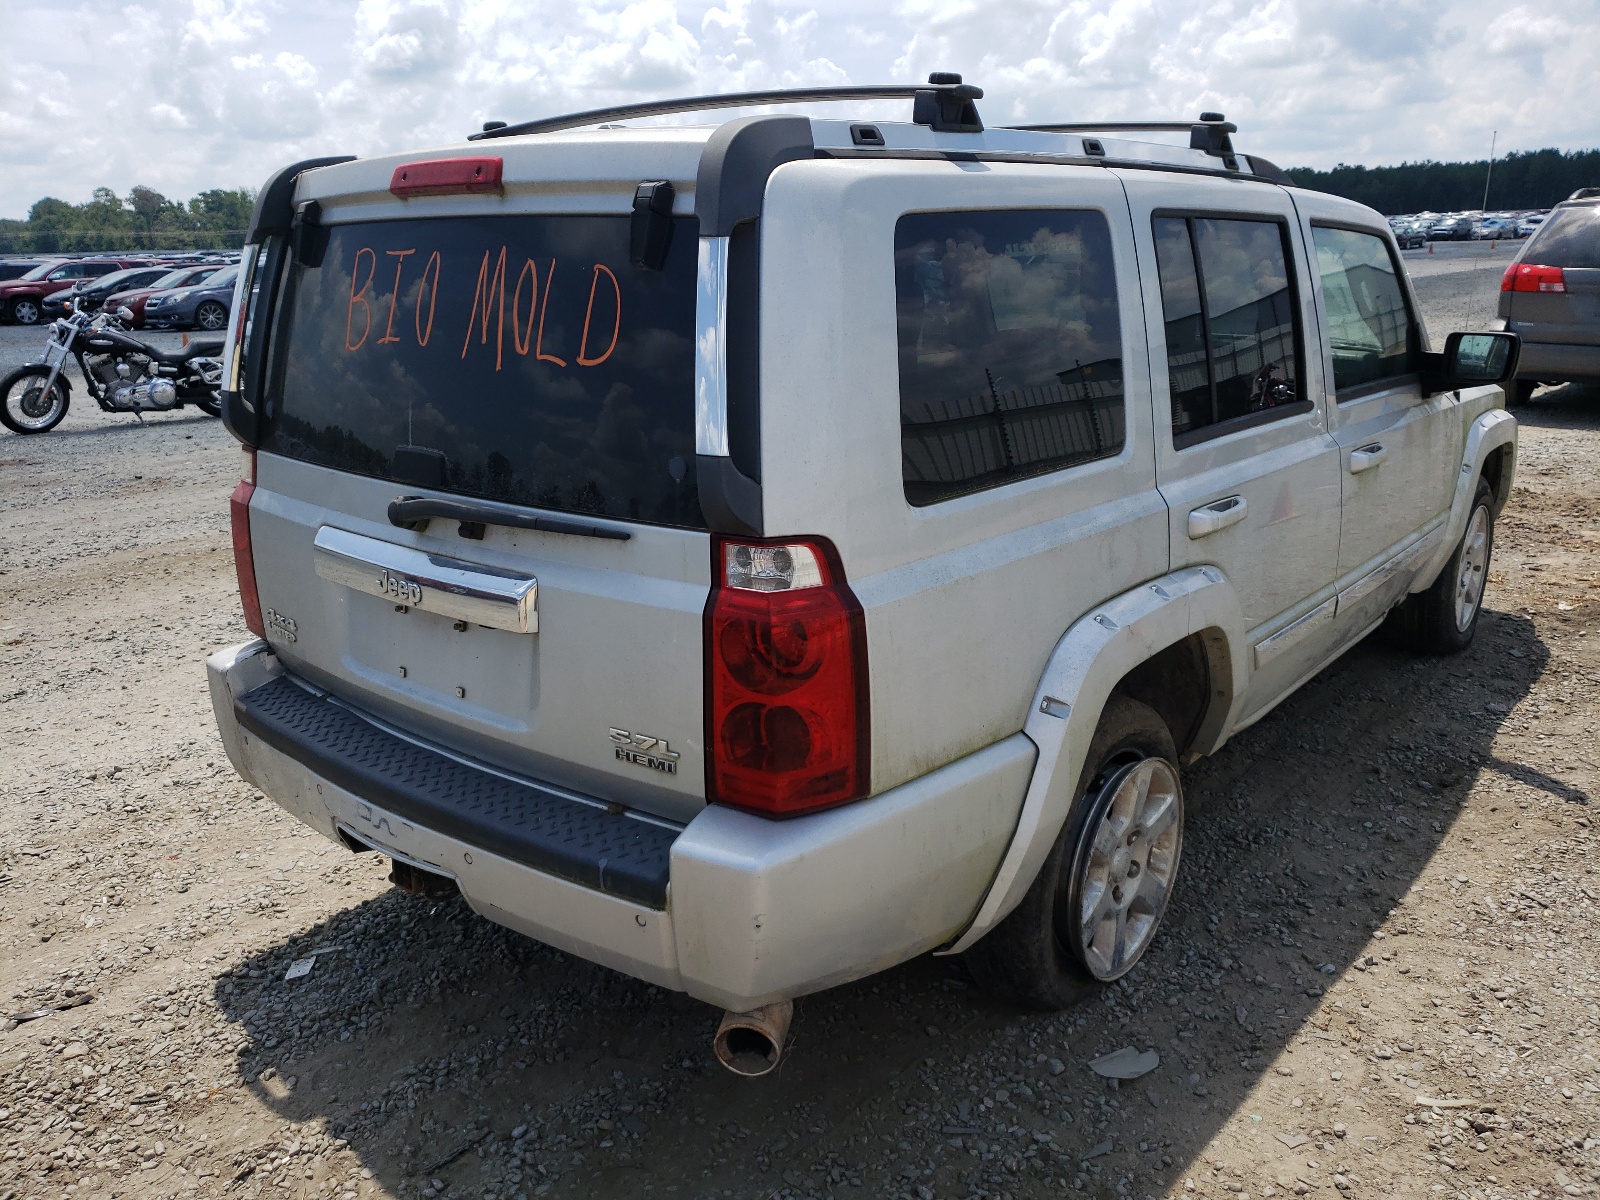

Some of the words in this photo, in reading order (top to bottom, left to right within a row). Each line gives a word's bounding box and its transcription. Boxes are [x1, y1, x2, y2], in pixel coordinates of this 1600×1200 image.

[345, 247, 441, 352] BIO
[461, 245, 622, 372] MOLD
[376, 569, 422, 606] Jeep
[608, 727, 680, 757] 5.7L
[615, 746, 677, 775] HEMI
